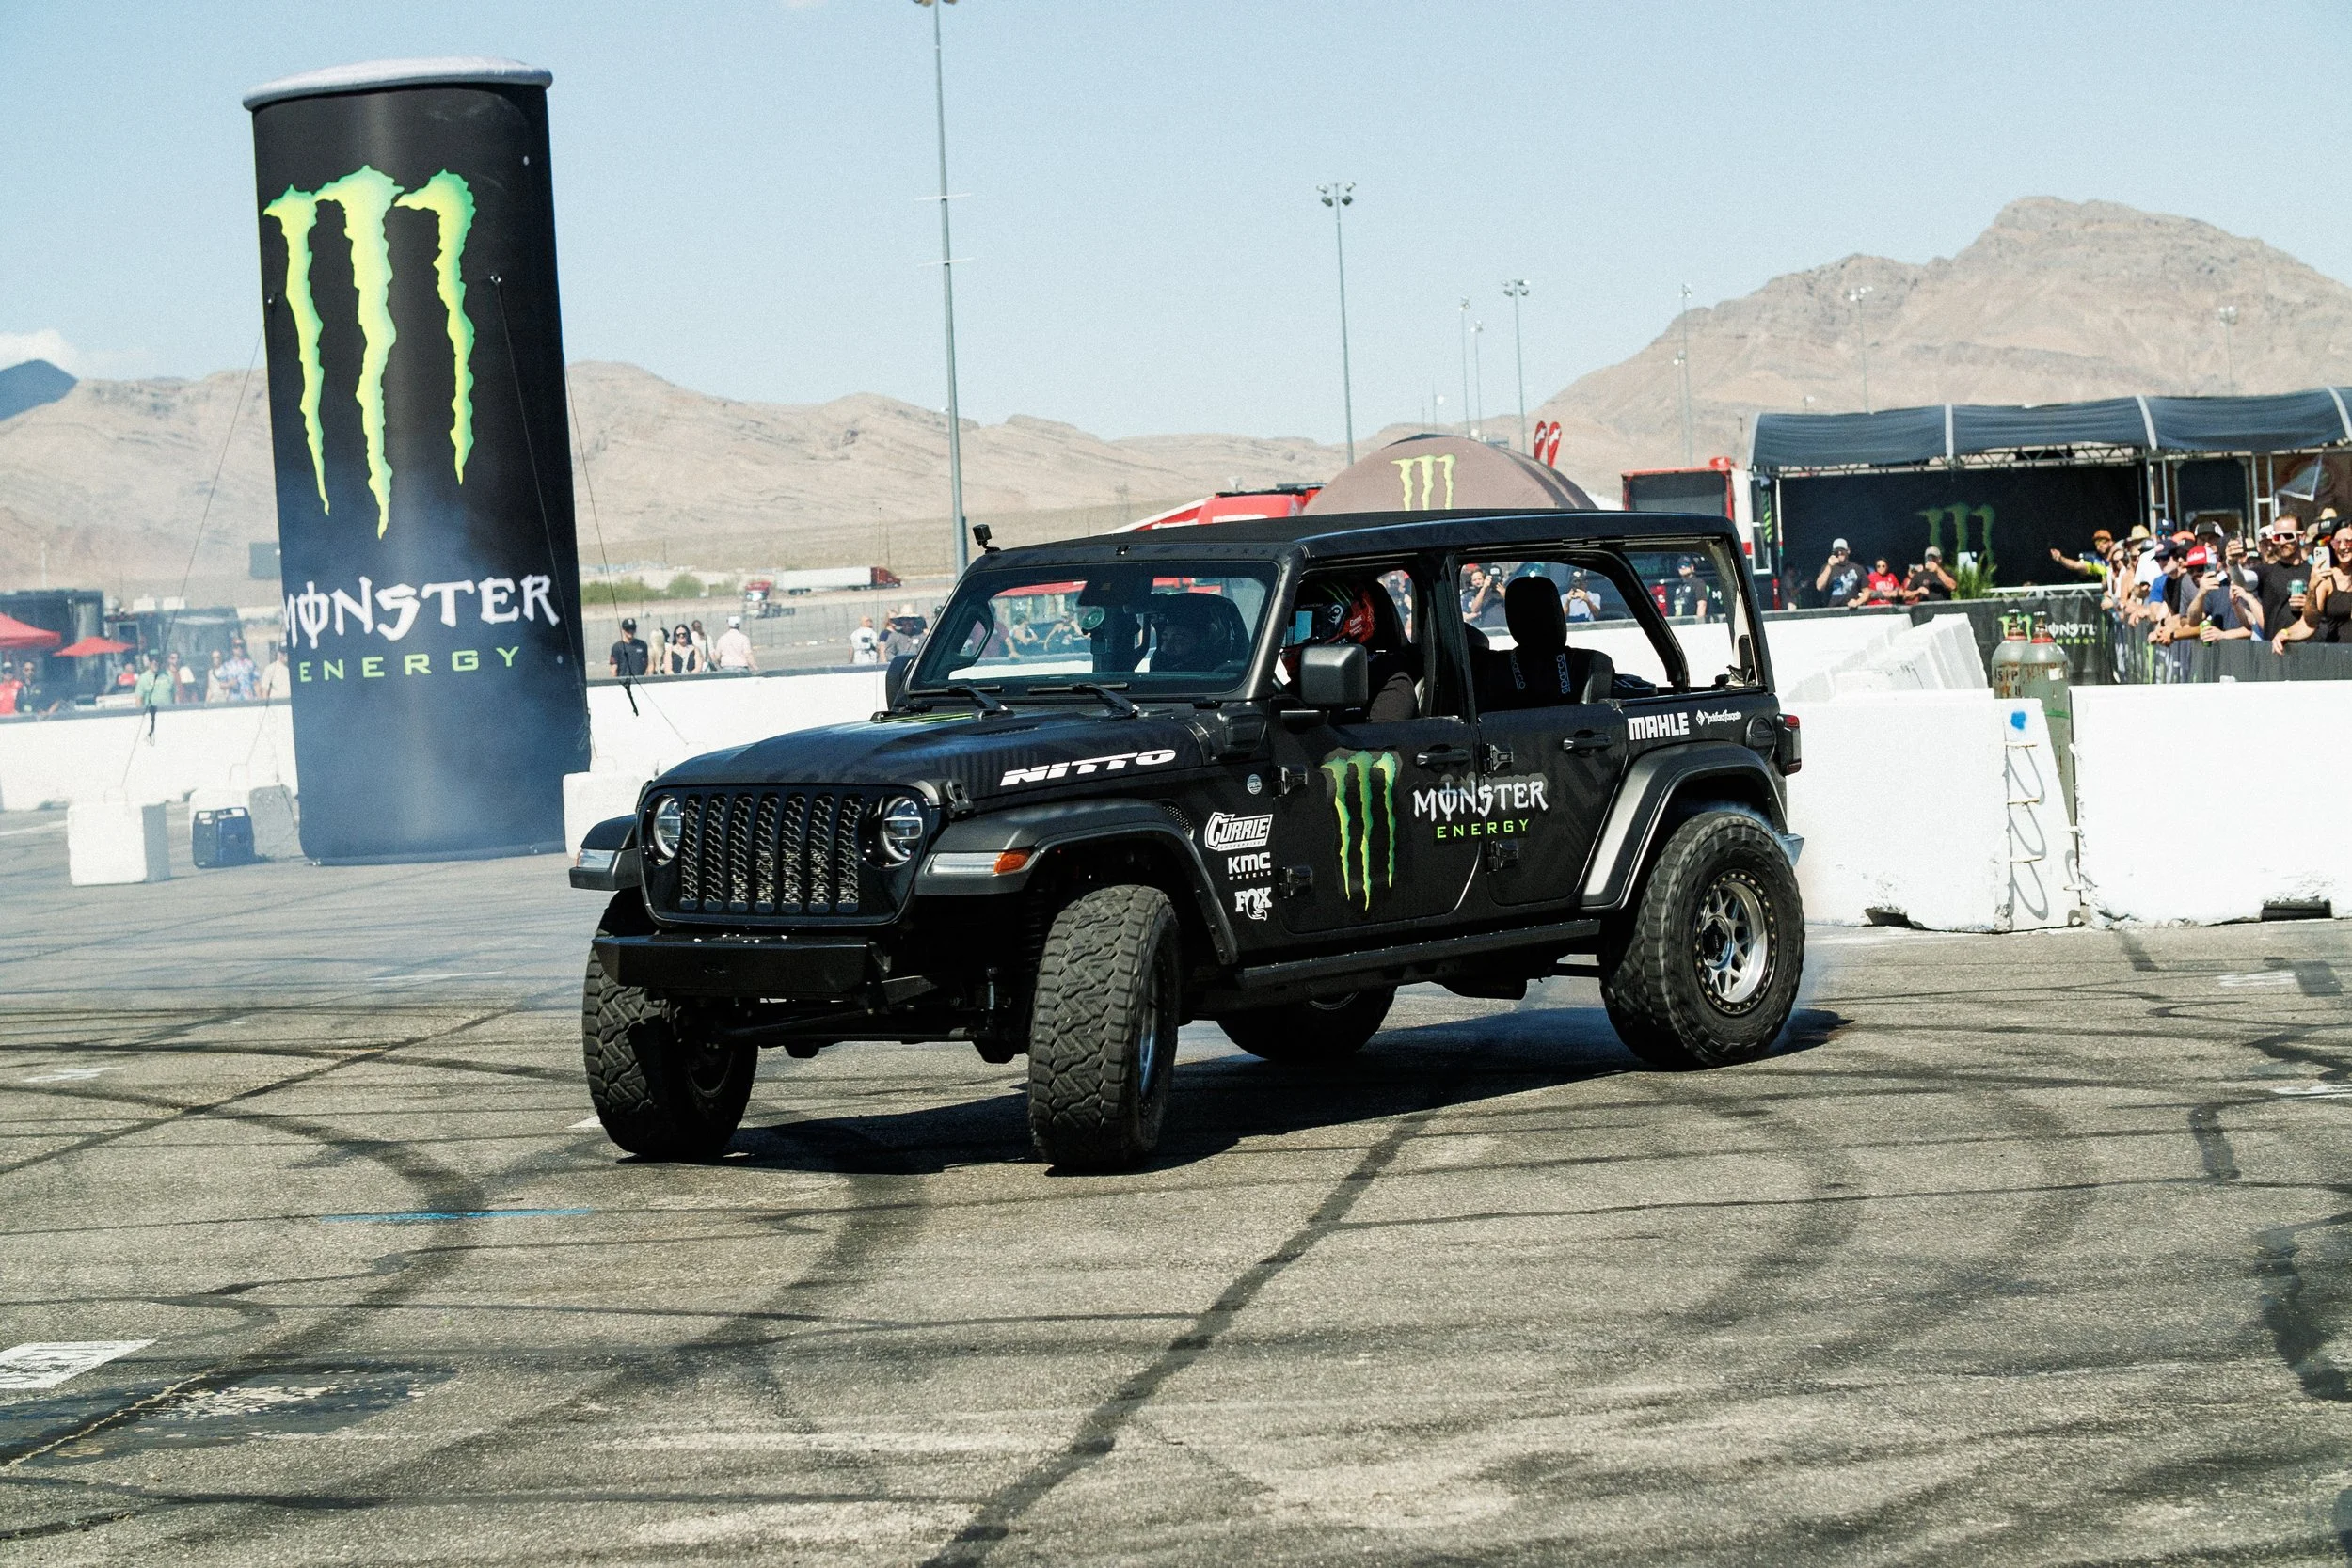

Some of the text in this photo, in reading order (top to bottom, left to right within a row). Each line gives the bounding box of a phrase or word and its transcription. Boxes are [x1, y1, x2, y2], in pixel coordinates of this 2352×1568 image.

[283, 575, 561, 649] MONSTER
[299, 646, 519, 682] ENERGY
[1556, 653, 1571, 694] sparco
[1627, 712, 1690, 741] MAHLE
[1000, 749, 1176, 787] NITTO
[1412, 780, 1549, 822] MONSTER
[1207, 815, 1269, 847] CURRIE
[1437, 819, 1529, 839] ENERGY
[1227, 851, 1272, 875] KMC
[1229, 870, 1272, 881] WHEELS
[1234, 886, 1273, 922] FOX
